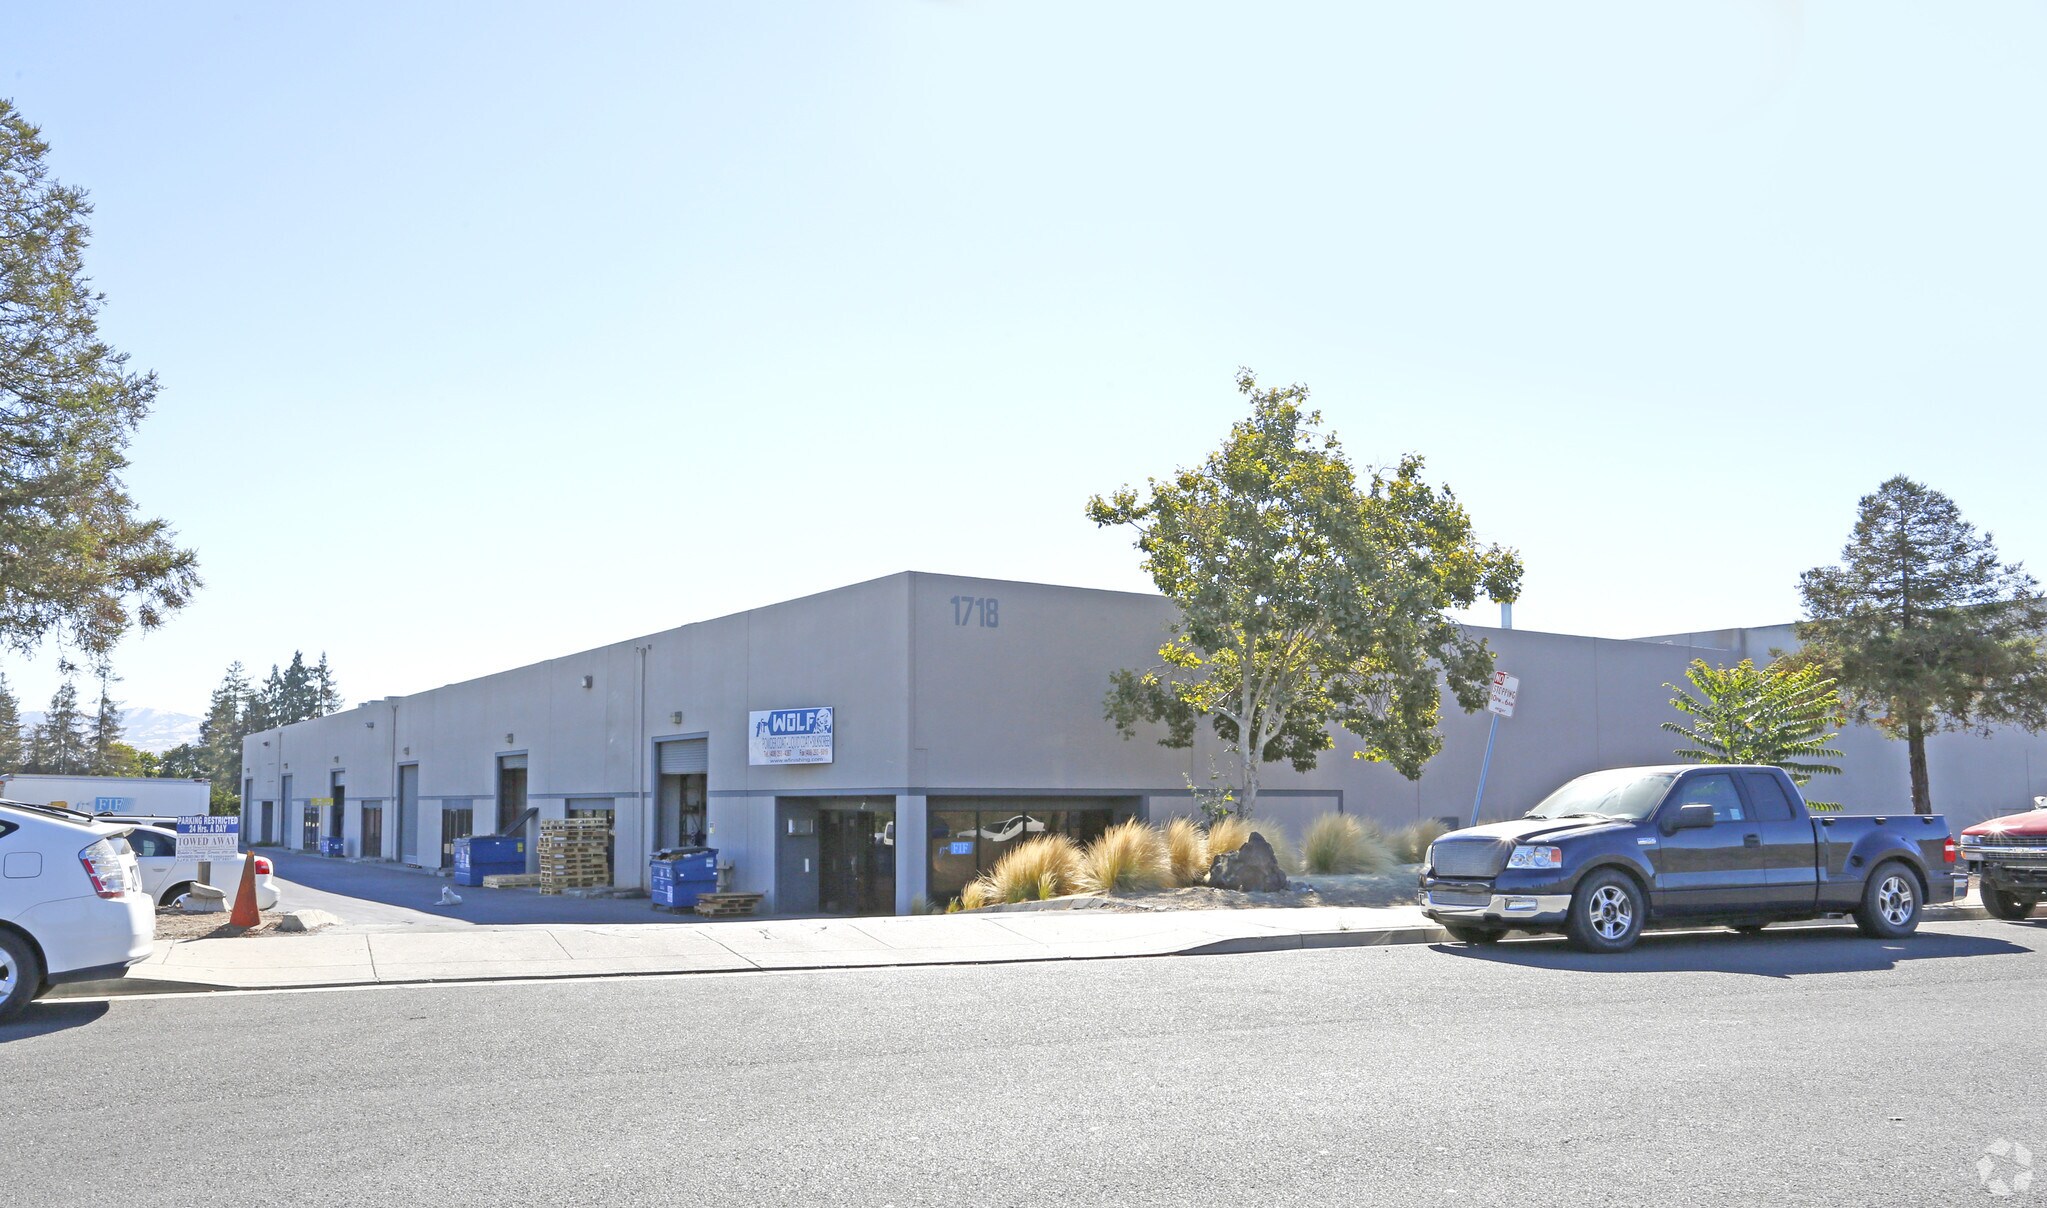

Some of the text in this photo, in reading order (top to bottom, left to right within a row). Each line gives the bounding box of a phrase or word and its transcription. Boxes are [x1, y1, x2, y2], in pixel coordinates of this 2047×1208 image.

[950, 595, 999, 628] 1718
[1496, 674, 1504, 685] NO
[1493, 685, 1516, 699] STOPPING
[773, 713, 815, 732] WOLF
[98, 798, 123, 811] FIF
[177, 816, 239, 825] PARKING RESTRICTED
[189, 824, 227, 833] 24 Hrs. A DAY
[178, 836, 237, 846] TOWED AWAY
[953, 842, 969, 854] FIF
